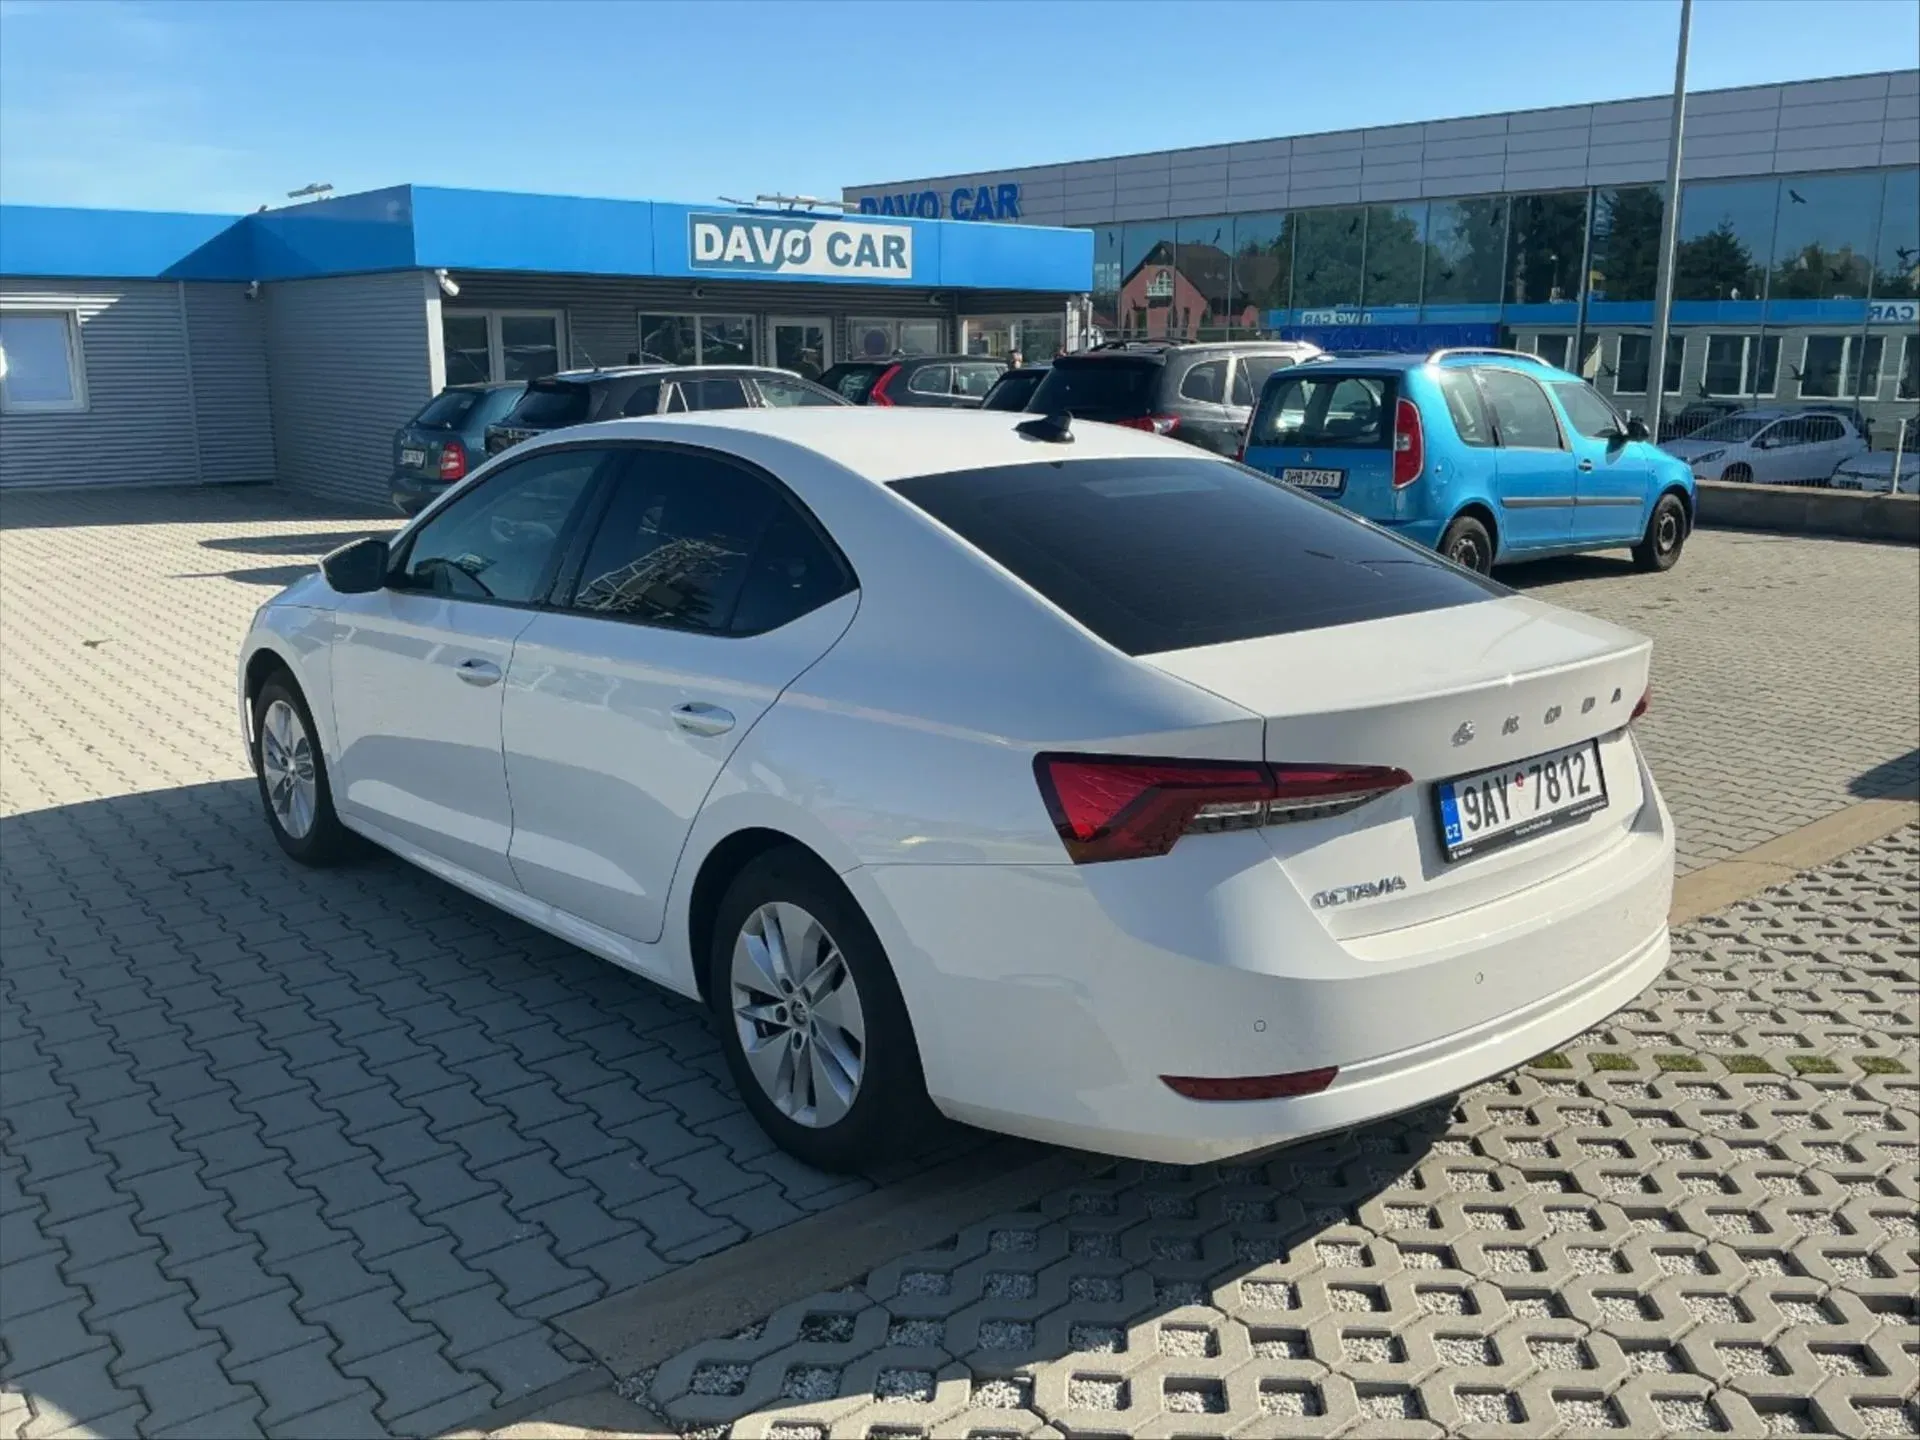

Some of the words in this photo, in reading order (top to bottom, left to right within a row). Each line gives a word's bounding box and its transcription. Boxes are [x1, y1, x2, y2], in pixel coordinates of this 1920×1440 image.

[861, 190, 940, 219] DAVO
[951, 183, 1019, 220] CAR
[695, 223, 811, 266] DAVO
[827, 231, 908, 269] CAR
[1463, 773, 1511, 832] 9AY
[1528, 751, 1591, 811] 7812
[1310, 875, 1407, 909] OCTAVIA
